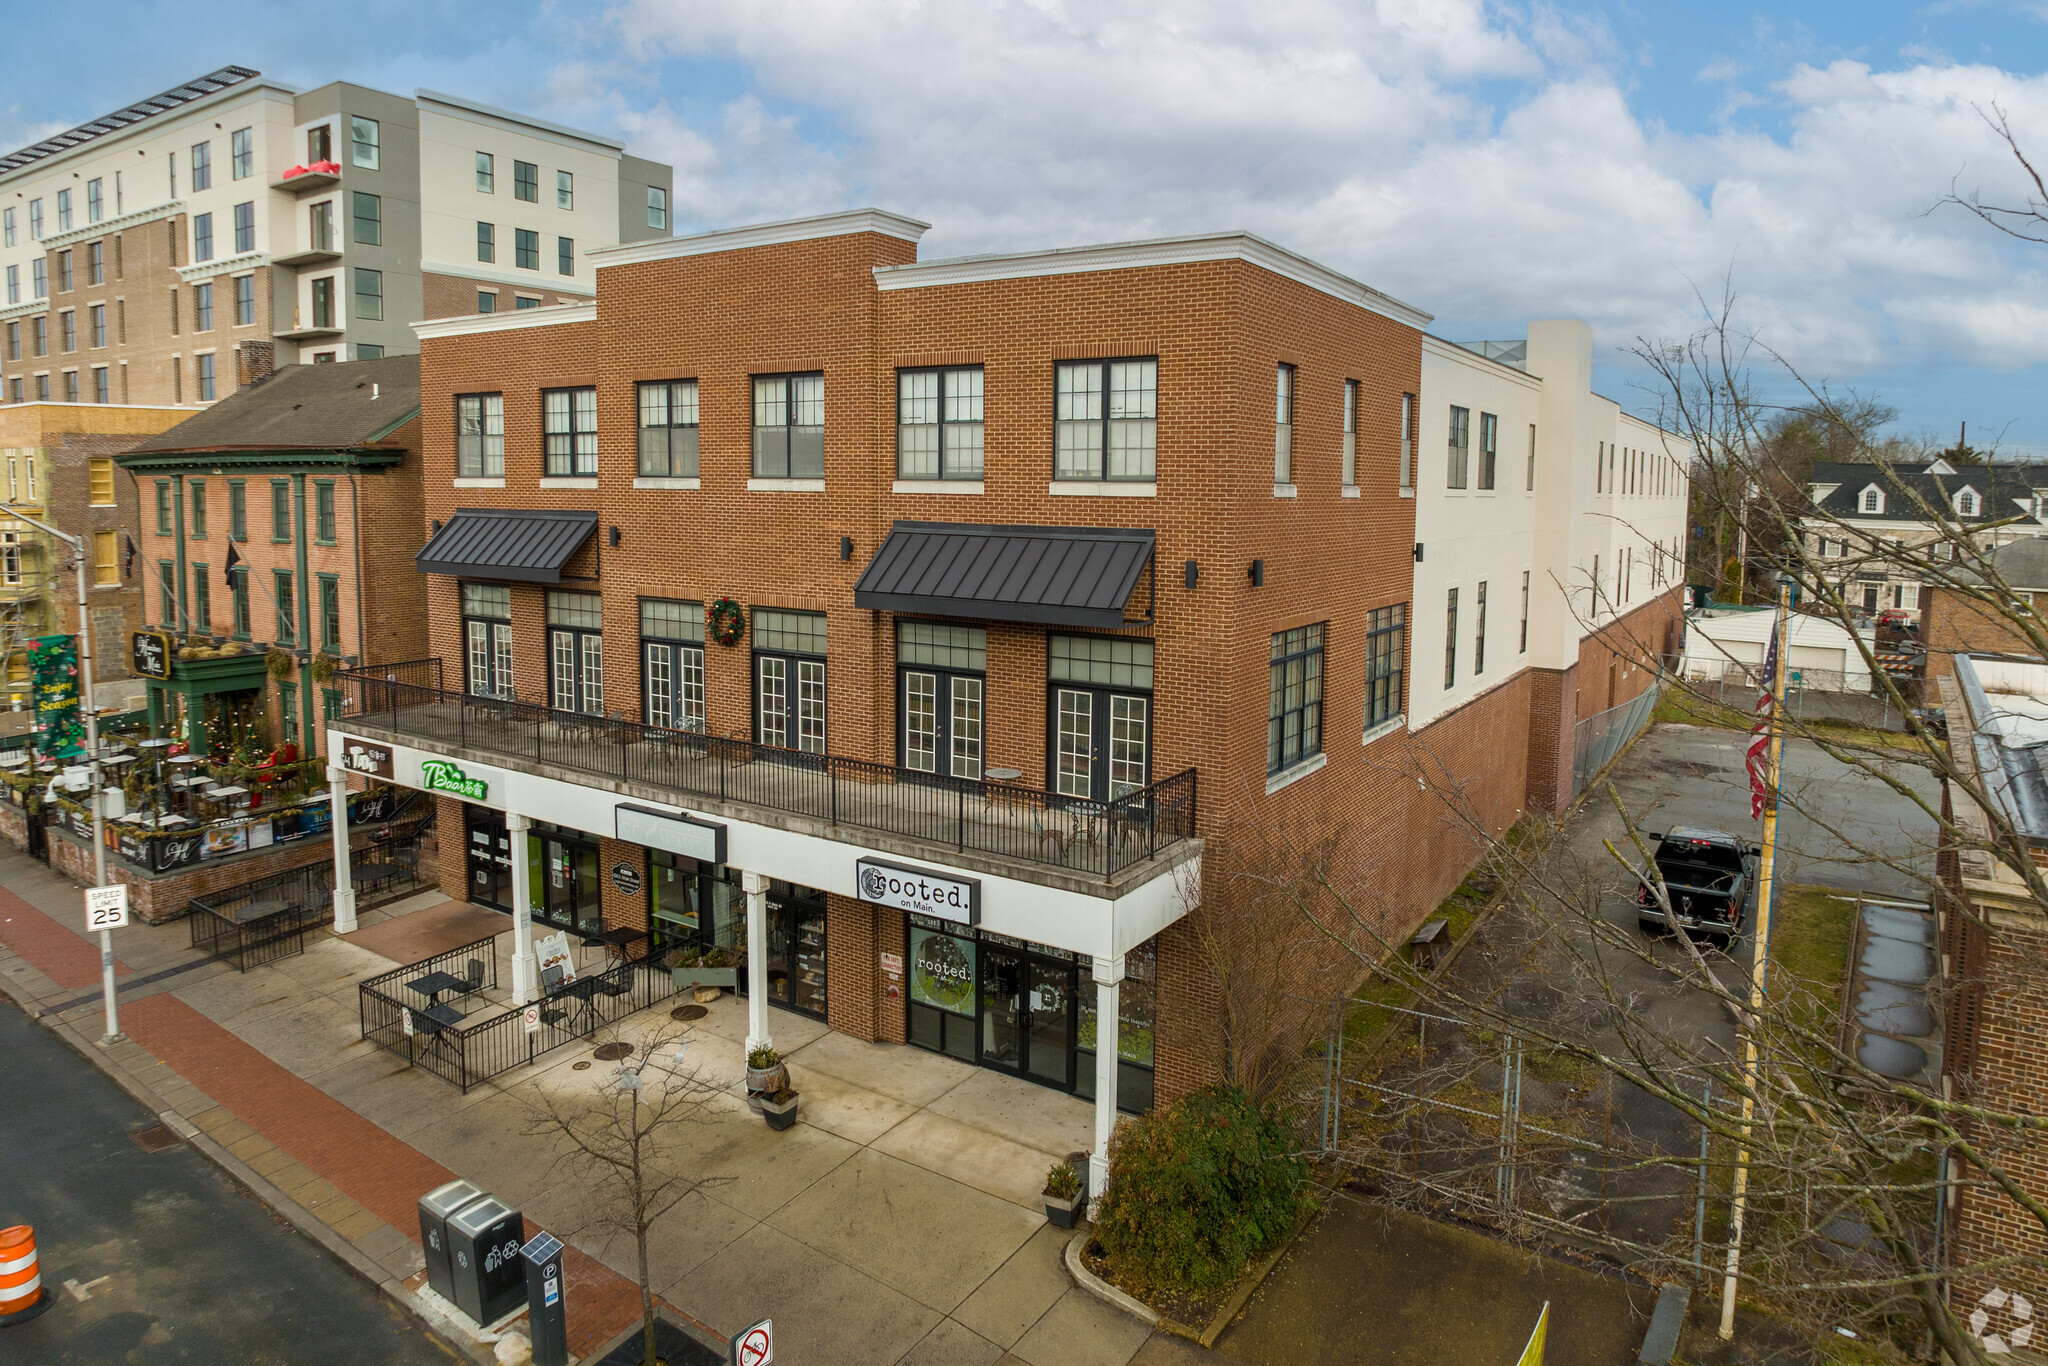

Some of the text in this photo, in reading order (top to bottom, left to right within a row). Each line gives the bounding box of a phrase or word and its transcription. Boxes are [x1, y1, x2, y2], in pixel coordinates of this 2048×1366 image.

[40, 682, 73, 695] Enjoy
[39, 697, 78, 712] Season
[92, 890, 122, 900] SPEED
[873, 874, 969, 910] rooted.
[95, 898, 119, 908] LIMIT
[900, 899, 936, 914] on Main.
[93, 907, 122, 925] 25
[917, 958, 971, 981] rooted.
